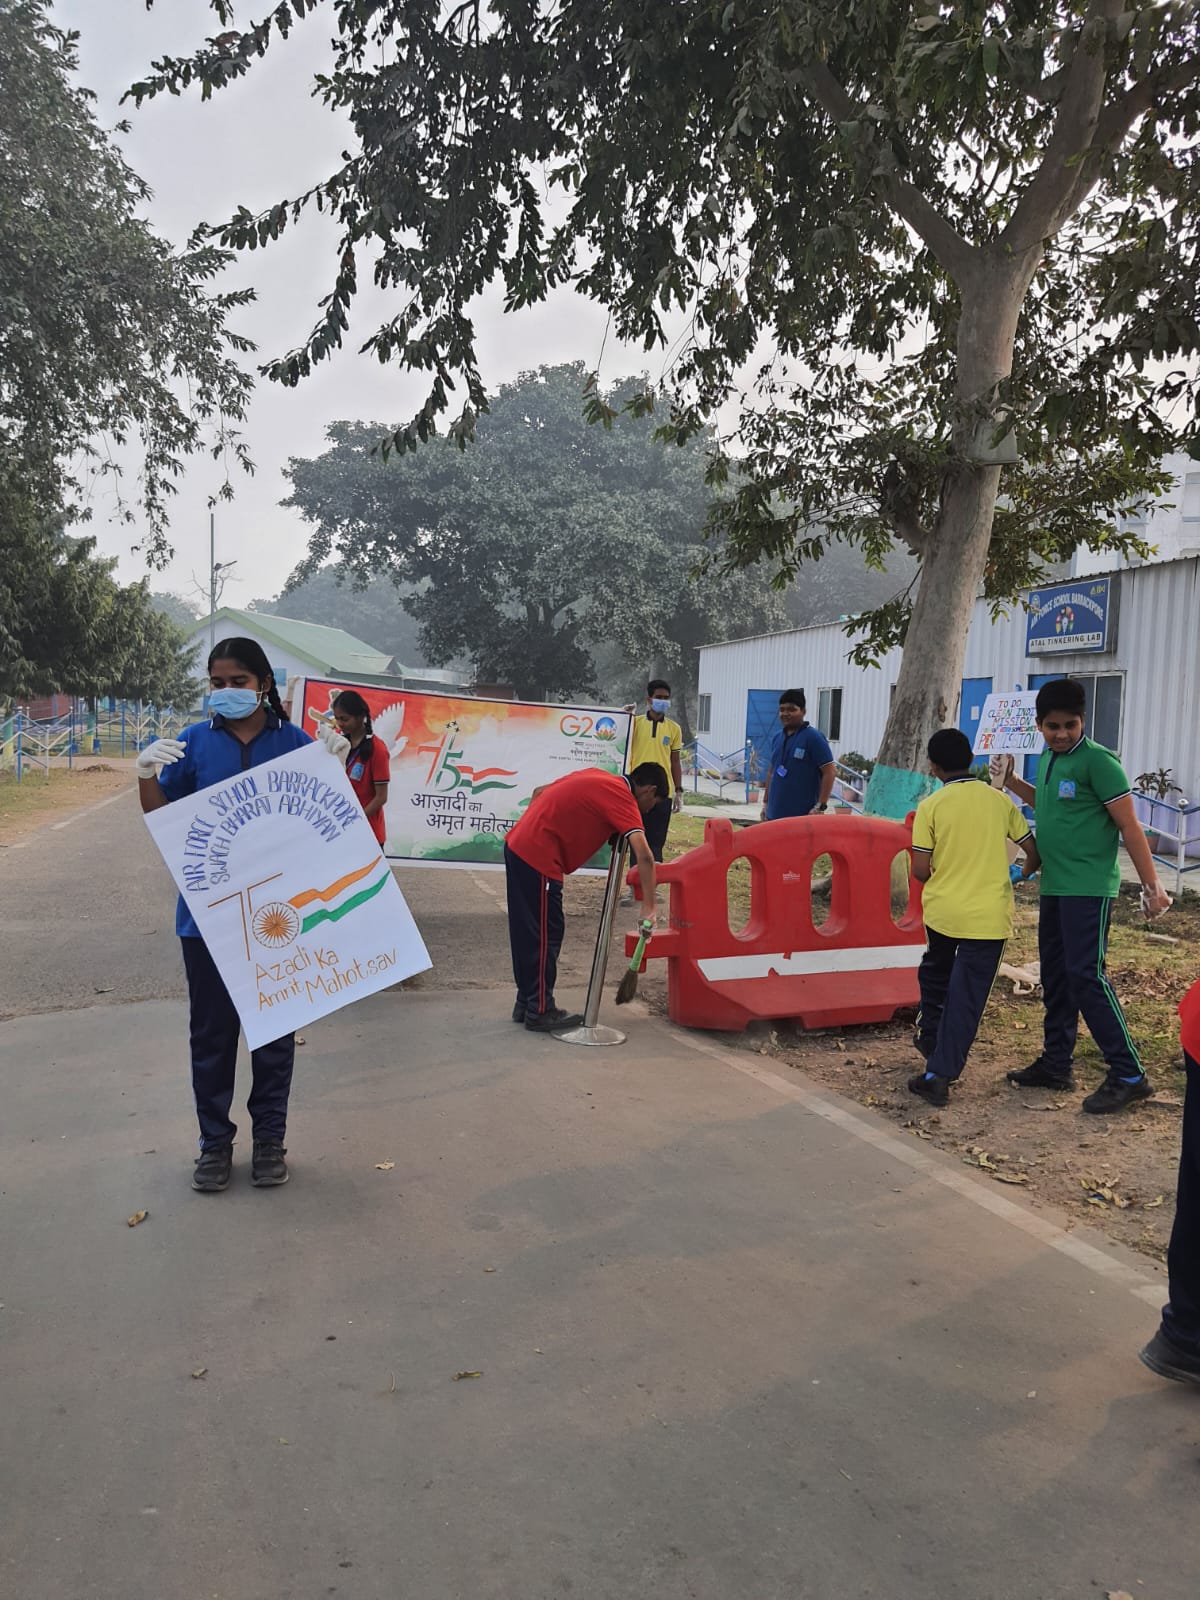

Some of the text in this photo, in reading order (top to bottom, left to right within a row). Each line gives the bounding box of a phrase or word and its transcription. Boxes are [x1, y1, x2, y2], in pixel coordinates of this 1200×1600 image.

[1053, 593, 1071, 609] SCHOOL
[1071, 593, 1104, 621] BARRACKPORE
[1047, 635, 1085, 645] TINKERING
[1087, 633, 1101, 641] LAB
[988, 707, 1036, 718] CLEAN INDI
[998, 699, 1022, 709] TO DO
[992, 717, 1032, 727] MISSION
[410, 791, 483, 813] आज़ादी का
[182, 770, 362, 892] AIR FORCE SCHOOL BARRACKPORE
[426, 812, 517, 835] अमृत महोत्स
[208, 793, 341, 885] SWACH BHARAT ABHIYAN
[255, 944, 312, 989] Azadi
[258, 948, 397, 1012] Amrit Mahotsav
